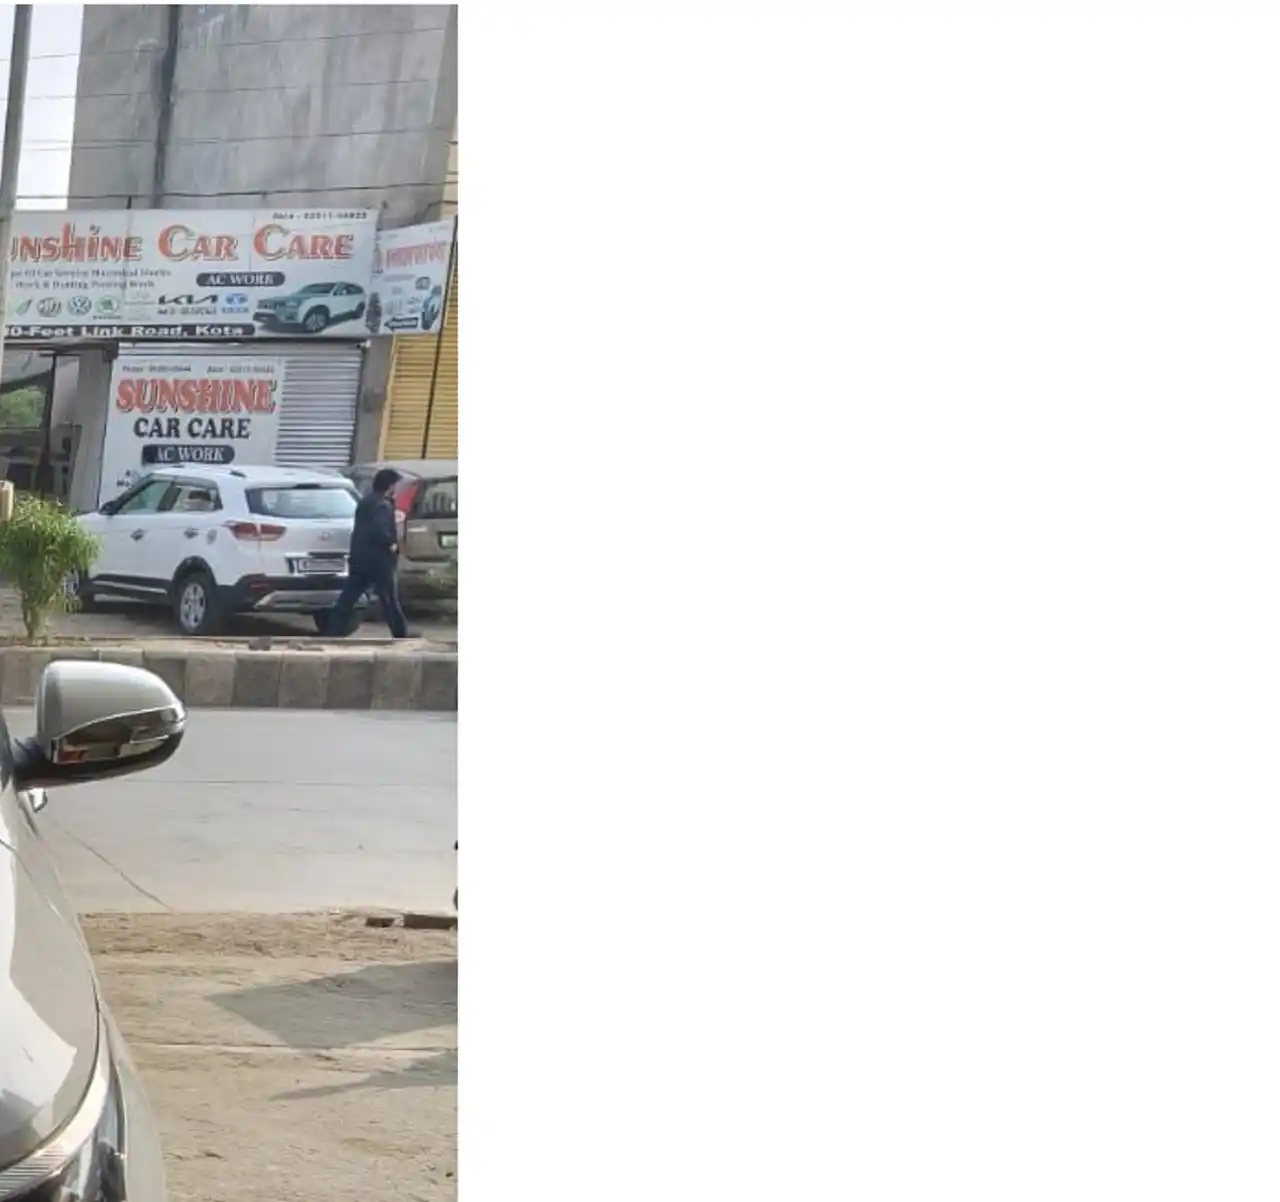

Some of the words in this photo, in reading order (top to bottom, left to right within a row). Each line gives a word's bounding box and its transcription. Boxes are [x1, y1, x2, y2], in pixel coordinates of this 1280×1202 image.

[206, 275, 228, 286] AC
[230, 275, 275, 286] WORK
[81, 325, 124, 338] Link
[196, 325, 244, 337] Kota
[116, 377, 277, 414] SUNSHINE
[133, 418, 180, 438] CAR
[187, 418, 252, 439] CARE
[155, 447, 172, 461] AC
[178, 446, 225, 462] WORK
